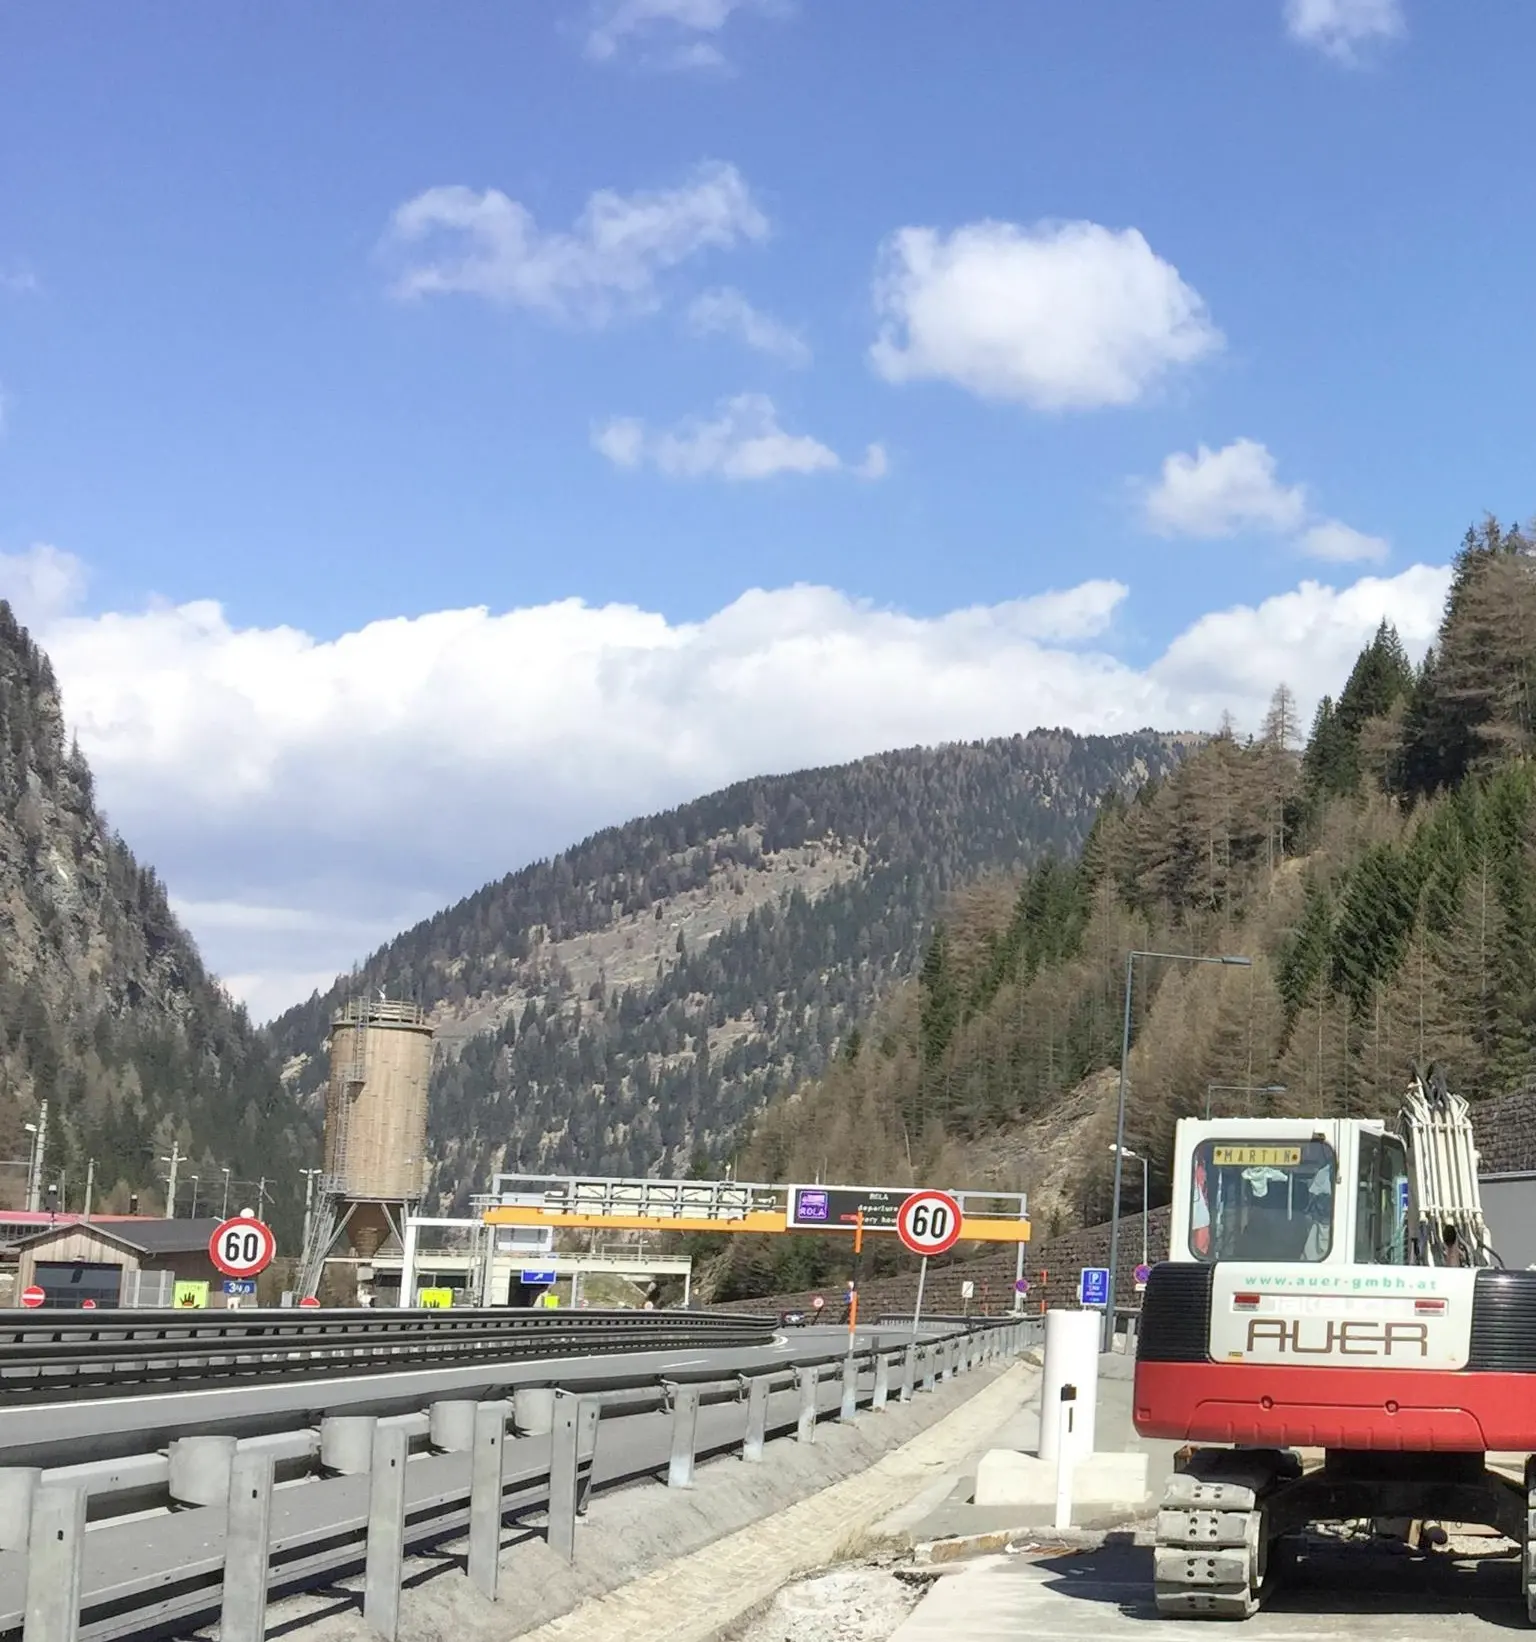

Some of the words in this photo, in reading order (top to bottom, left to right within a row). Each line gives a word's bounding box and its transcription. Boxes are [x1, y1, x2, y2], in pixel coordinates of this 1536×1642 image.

[1224, 1149, 1291, 1163] MARTIN
[799, 1206, 826, 1216] ROLA
[911, 1205, 948, 1239] 60
[225, 1232, 259, 1262] 60
[1244, 1275, 1438, 1290] www.auer-gmbh.at
[1246, 1318, 1428, 1357] AUER
